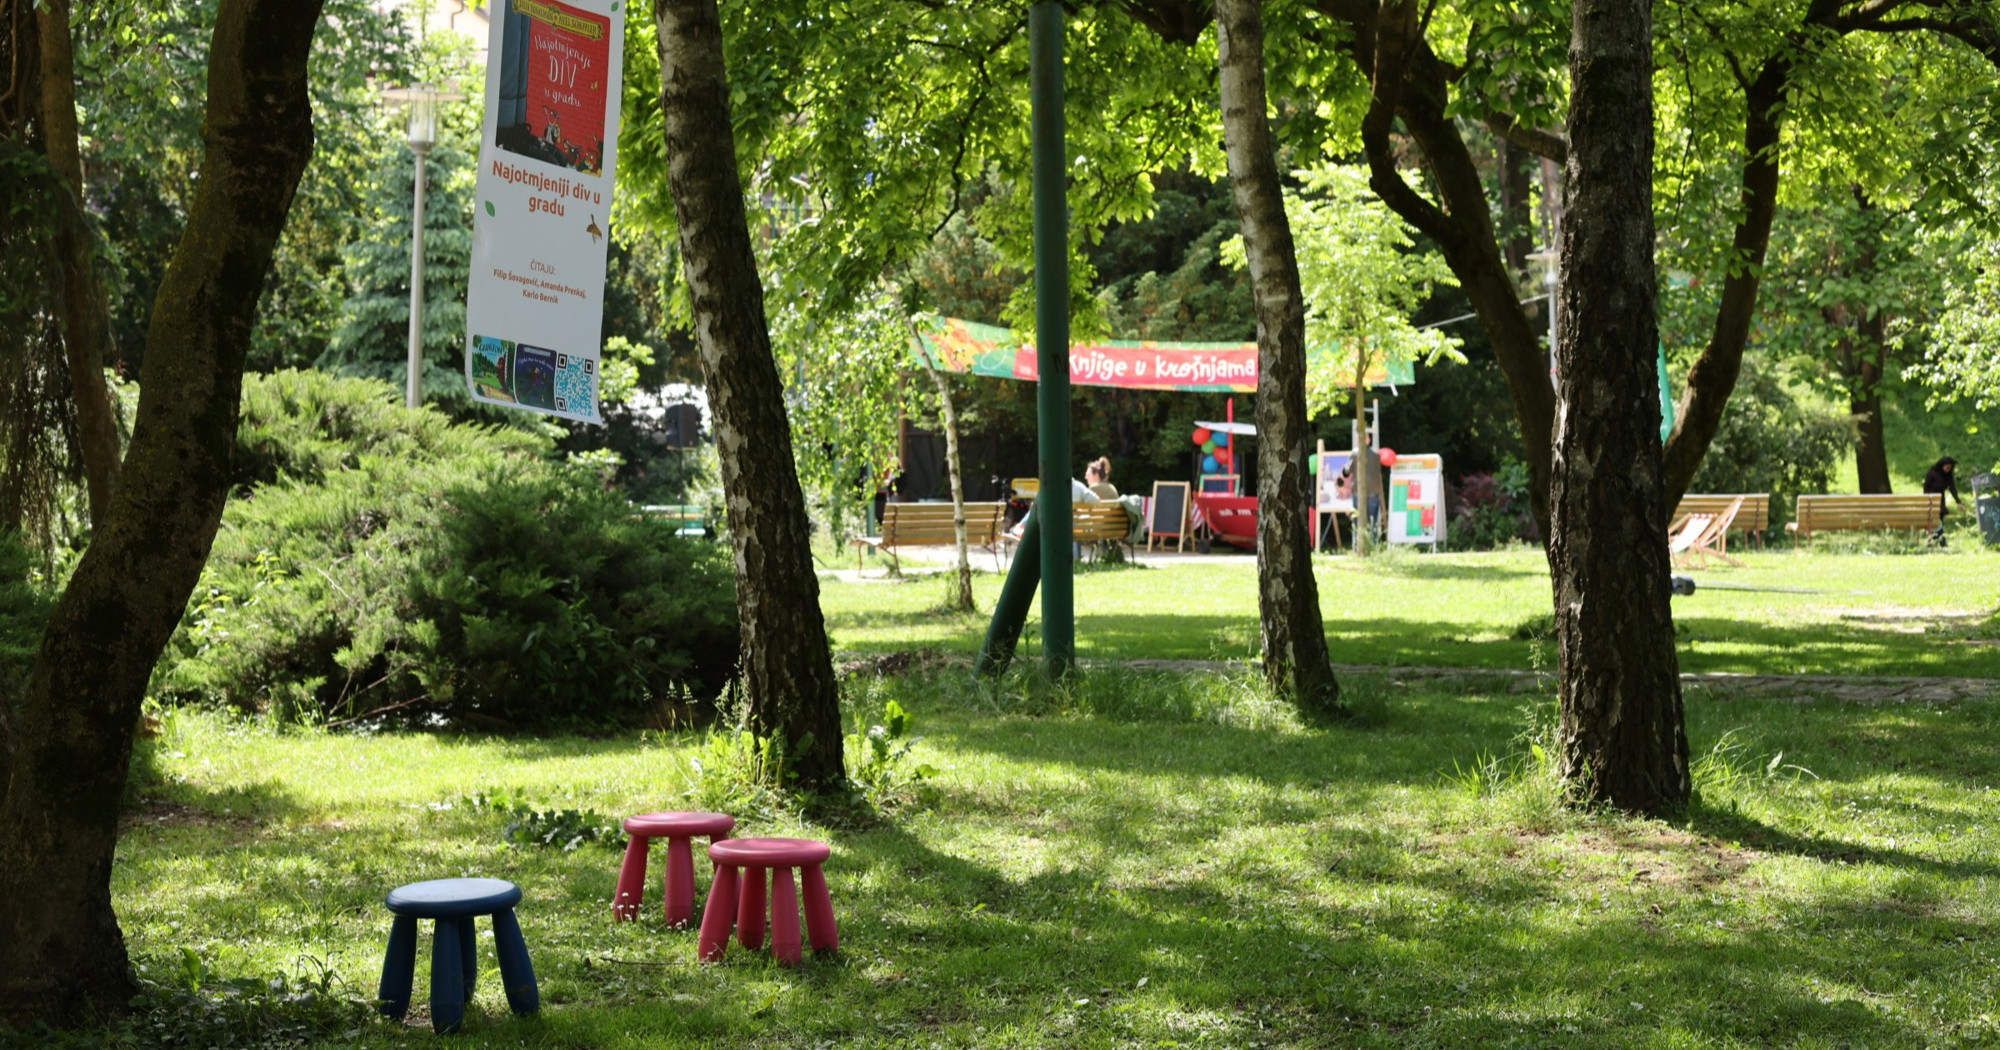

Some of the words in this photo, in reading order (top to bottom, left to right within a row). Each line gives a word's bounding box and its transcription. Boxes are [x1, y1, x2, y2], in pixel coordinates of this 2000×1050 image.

[534, 35, 591, 69] Najotmjeniji
[548, 55, 577, 88] DIV
[552, 90, 580, 107] gradu
[492, 160, 569, 197] Najotmjeniji
[573, 182, 590, 201] div
[593, 192, 600, 205] u
[528, 196, 565, 216] gradu
[530, 259, 556, 275] ČITAJU:
[493, 269, 507, 280] Filip
[540, 280, 564, 293] Amanda
[522, 289, 538, 300] Karlo
[539, 293, 559, 304] Bernik
[1135, 361, 1146, 376] u
[1155, 354, 1256, 382] krošnjama
